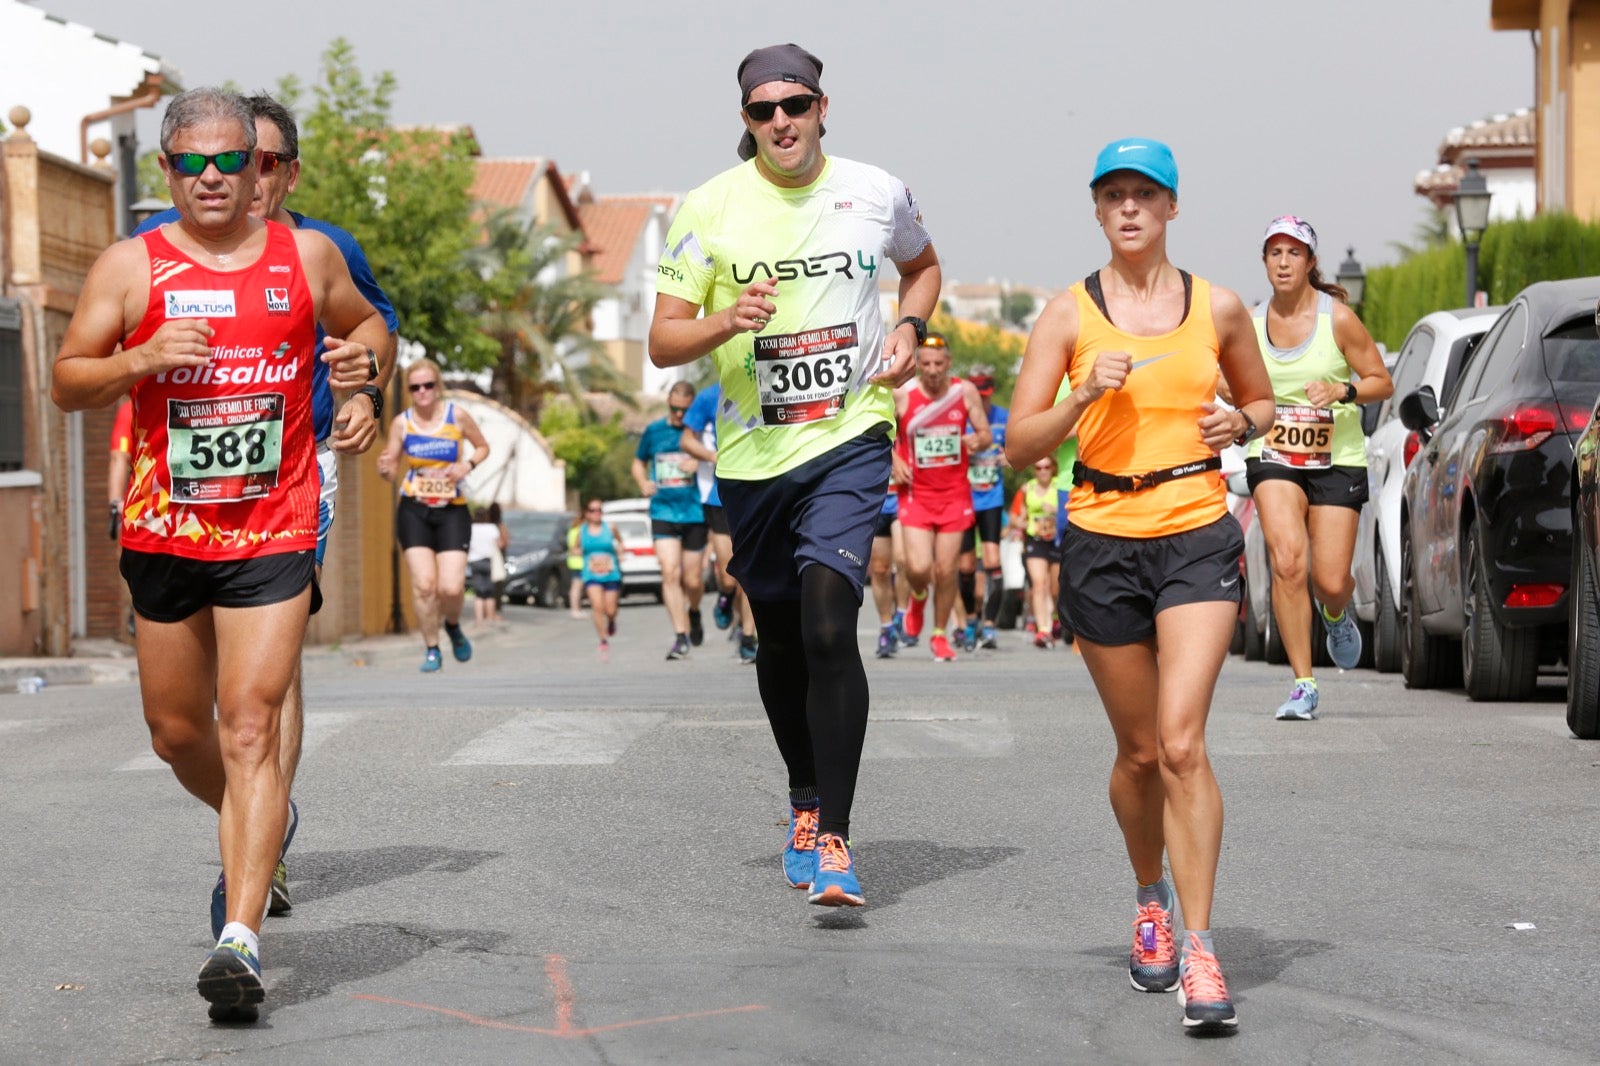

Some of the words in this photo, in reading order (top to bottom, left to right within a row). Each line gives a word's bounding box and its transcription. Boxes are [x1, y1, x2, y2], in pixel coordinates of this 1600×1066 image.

[267, 289, 273, 302] I
[267, 302, 290, 310] MOVE
[759, 338, 778, 350] XXXII
[778, 336, 797, 349] GRAN
[797, 332, 821, 347] PREMIO
[821, 329, 830, 340] DE
[831, 326, 852, 339] FONDO
[770, 354, 852, 394] 3063
[190, 401, 212, 417] GRAN
[213, 399, 242, 414] PREMIO
[243, 398, 253, 411] DE
[190, 415, 223, 428] DIPUTACIÓN
[924, 438, 954, 453] 425
[1273, 425, 1330, 448] 2005
[189, 428, 267, 470] 588
